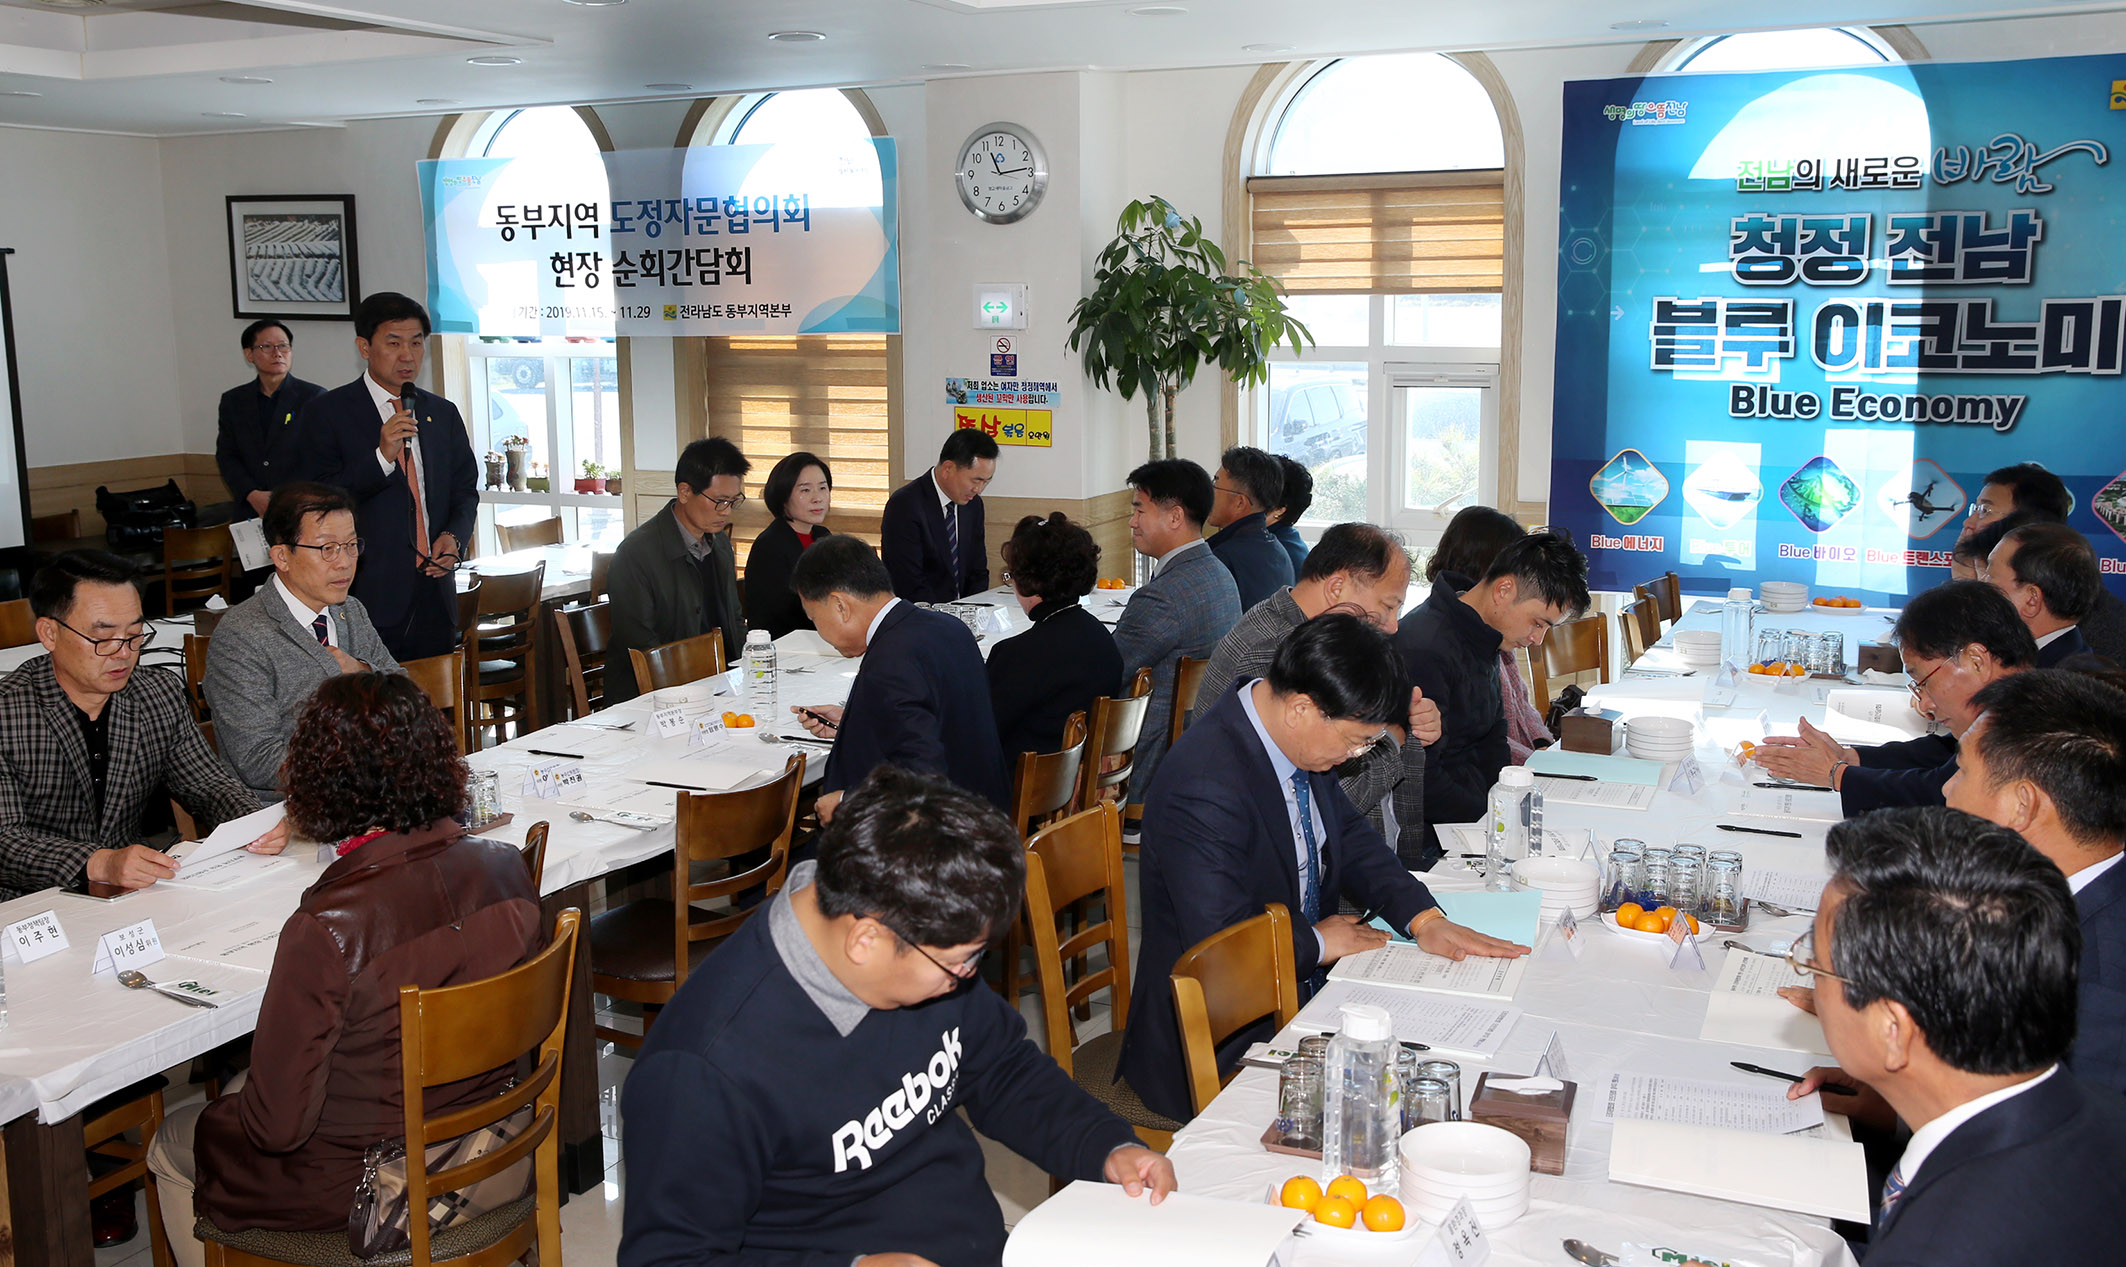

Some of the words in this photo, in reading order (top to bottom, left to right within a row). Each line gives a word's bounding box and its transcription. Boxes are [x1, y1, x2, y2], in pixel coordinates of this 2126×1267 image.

[995, 136, 1004, 146] 12
[972, 153, 982, 164] 10
[1022, 150, 1029, 161] 2
[1738, 159, 1822, 190] 전남의
[1830, 156, 1921, 189] 새로운
[1933, 134, 2107, 193] 바람
[967, 170, 975, 180] 9
[1027, 167, 1034, 178] 3
[973, 186, 980, 196] 8
[1022, 184, 1029, 194] 4
[984, 196, 991, 207] 7
[998, 201, 1006, 212] 6
[1012, 195, 1020, 206] 5
[496, 202, 599, 242] 동부지역
[610, 193, 811, 239] 도정자문협의회
[1730, 213, 1872, 286] 청정
[1885, 210, 2044, 285] 전남
[550, 251, 602, 289] 현장
[612, 246, 752, 288] 순회간담회
[620, 305, 651, 319] 11.29
[679, 304, 723, 320] 전라남도
[725, 303, 792, 320] 동부지역본부
[1650, 296, 1796, 371] 블루
[1810, 296, 2123, 375] 이코노미
[1000, 381, 1019, 392] 여자만
[1729, 384, 1819, 420] Blue
[1829, 386, 2026, 428] Economy
[1591, 534, 1622, 549] Blue
[1622, 535, 1664, 552] 에너지
[1779, 545, 1811, 558] Blue
[1813, 546, 1857, 561] 바이오
[1866, 550, 1899, 563] Blue
[2100, 558, 2126, 573] Blu
[114, 938, 146, 958] 이성심
[832, 1027, 962, 1173] Reebok
